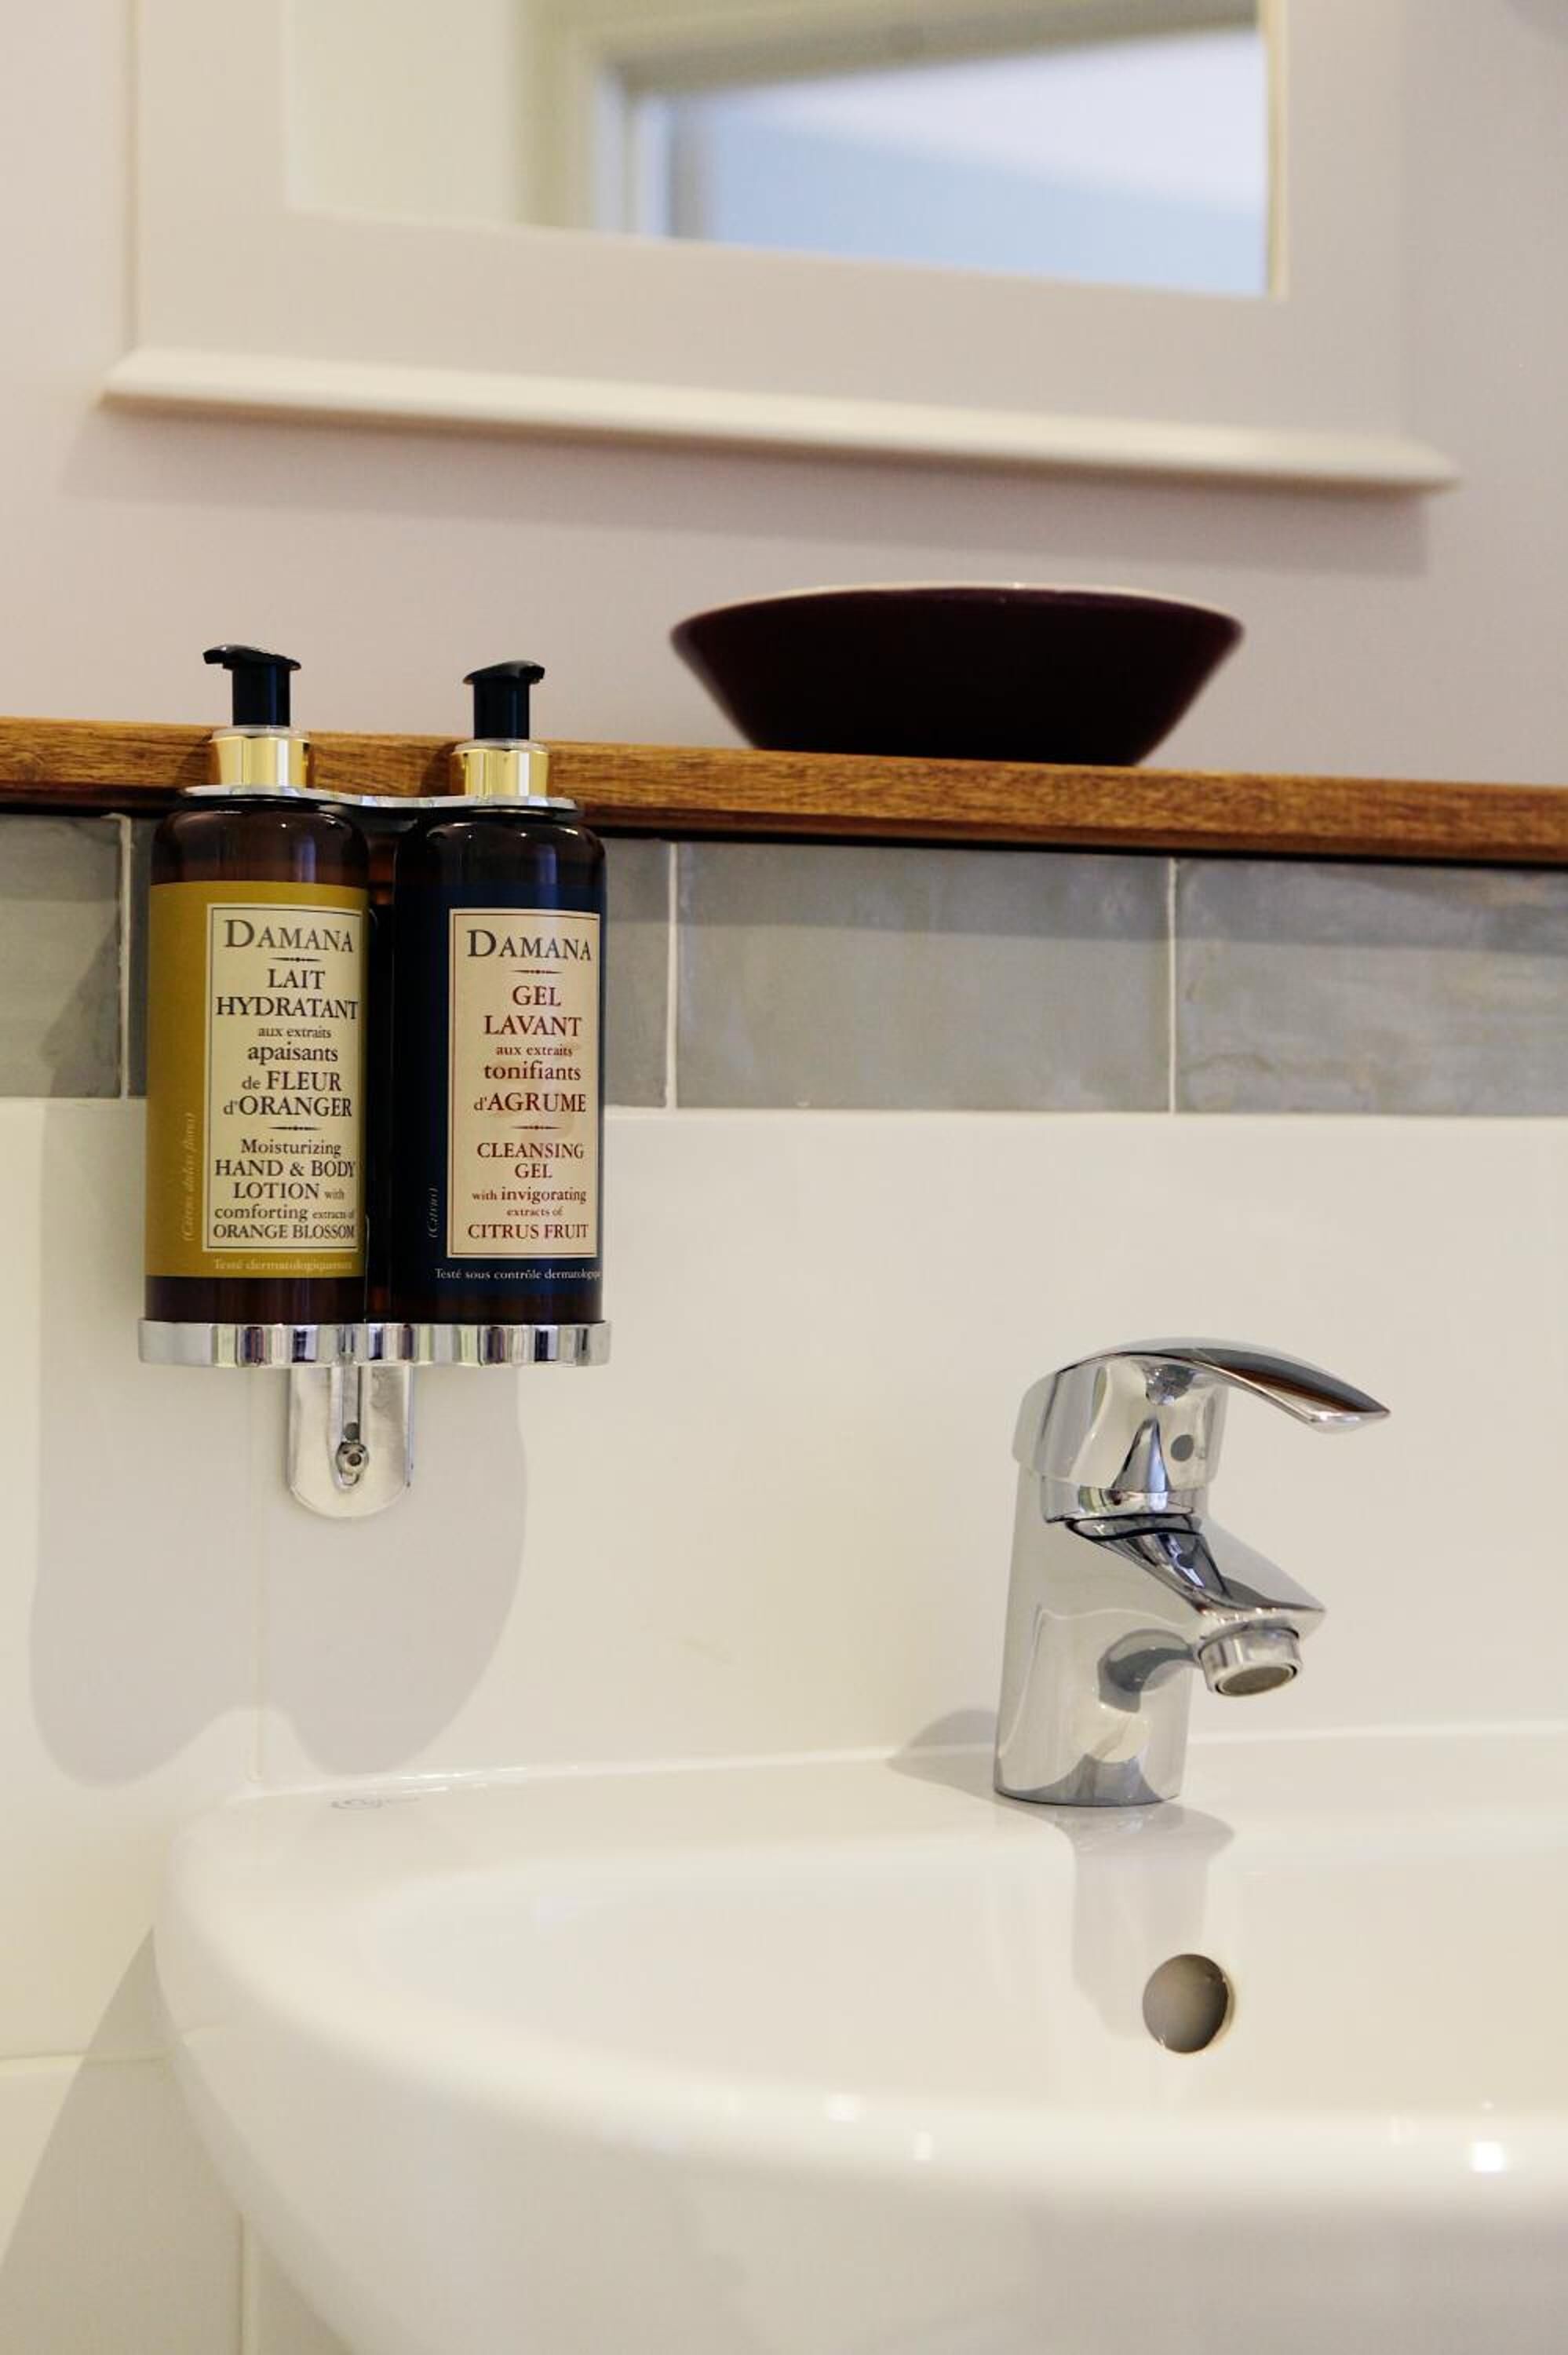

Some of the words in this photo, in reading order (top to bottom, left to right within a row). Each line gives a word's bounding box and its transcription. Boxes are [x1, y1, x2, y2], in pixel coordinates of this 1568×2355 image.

[268, 968, 326, 989] LAIT
[512, 986, 561, 1006] GEL
[216, 996, 359, 1020] HYDRATANT
[257, 1027, 283, 1037] aux
[286, 1025, 332, 1039] extraits
[483, 1015, 582, 1037] LAVANT
[247, 1040, 338, 1065] apaisants
[496, 1046, 522, 1056] aux
[527, 1044, 573, 1057] extraits
[484, 1061, 582, 1081] tonifiants
[242, 1075, 261, 1090] de
[266, 1070, 342, 1092] FLEUR
[223, 1095, 352, 1118] d'ORANGER
[473, 1093, 586, 1112] d'AGRUME
[241, 1138, 341, 1157] Moisturizing
[477, 1143, 584, 1159] CLEANSING
[215, 1159, 283, 1178] HAND
[290, 1161, 305, 1177] &
[311, 1160, 355, 1178] BODY
[514, 1163, 552, 1178] GEL
[233, 1181, 319, 1199] LOTION
[324, 1188, 345, 1200] with
[472, 1189, 497, 1200] with
[501, 1187, 587, 1204] invigorating
[214, 1203, 308, 1222] comforting
[552, 1207, 563, 1216] of
[213, 1224, 288, 1239] ORANGE
[292, 1224, 355, 1240] BLOSSOM
[468, 1224, 539, 1239] CITRUS
[544, 1224, 589, 1239] FRUIT
[435, 1268, 461, 1279] Testé
[465, 1270, 490, 1279] sous
[494, 1268, 542, 1279] contrôle
